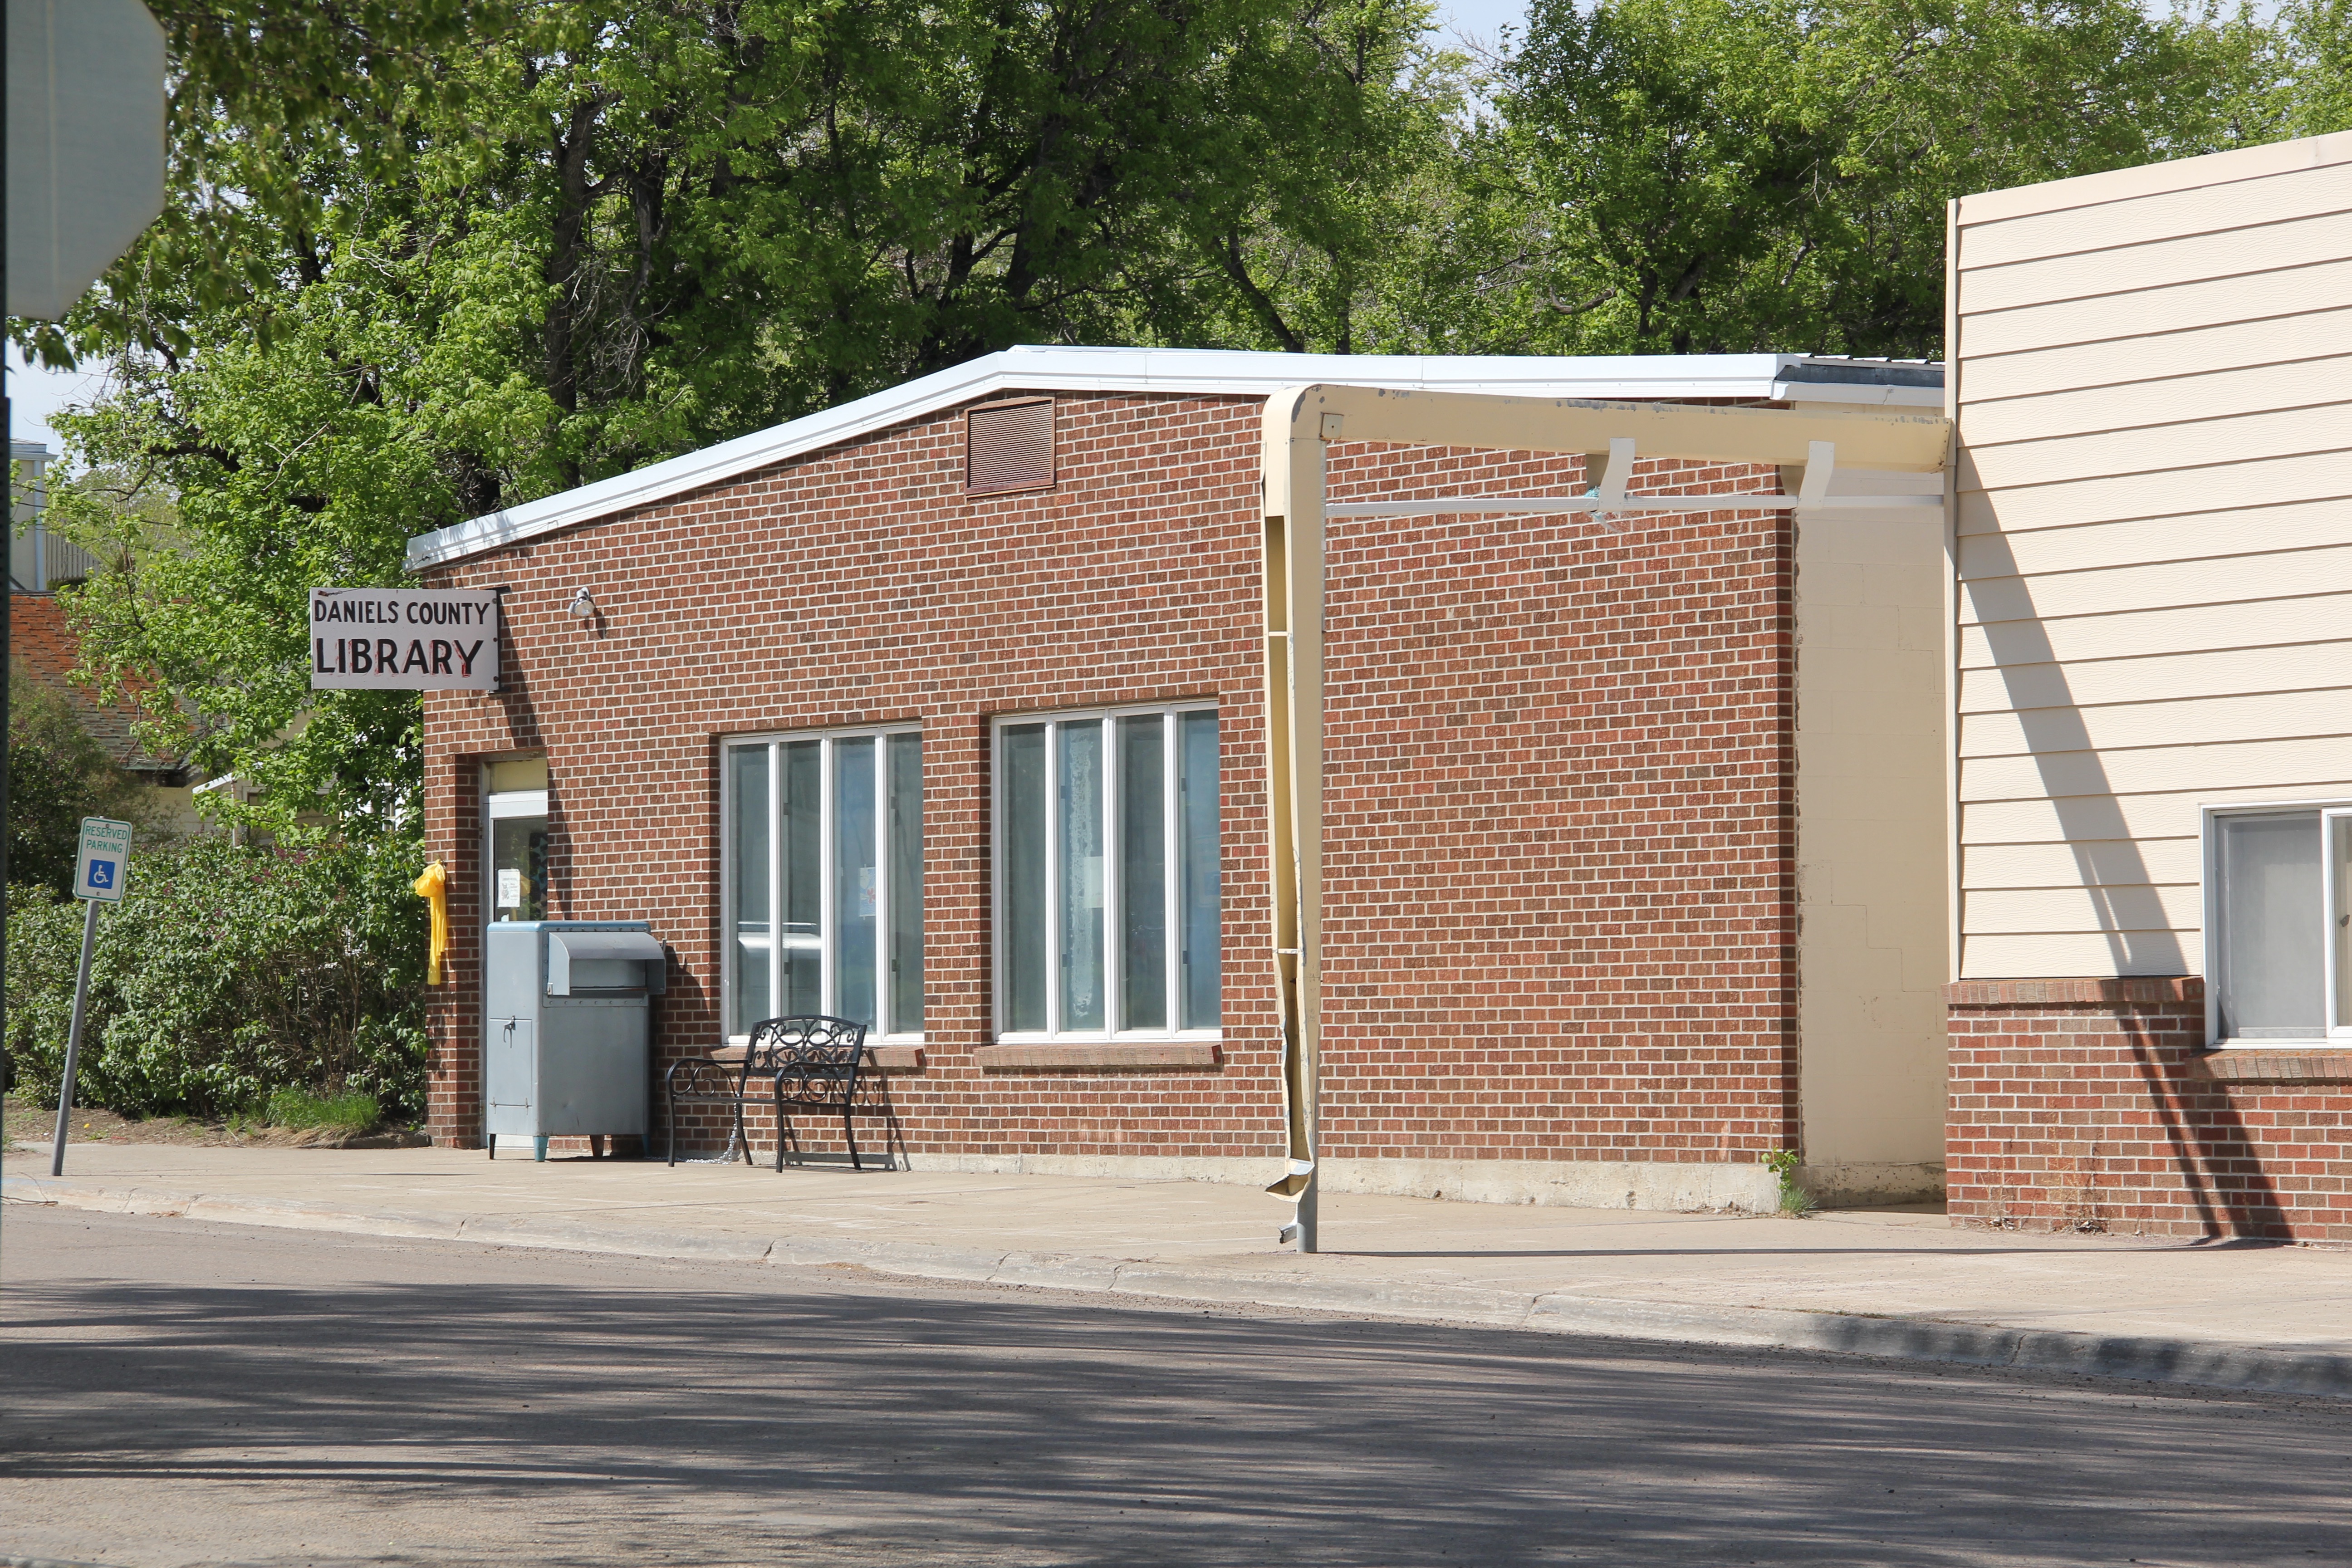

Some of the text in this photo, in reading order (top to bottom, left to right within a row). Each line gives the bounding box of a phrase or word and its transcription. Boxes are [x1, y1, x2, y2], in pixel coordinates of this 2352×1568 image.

[314, 599, 490, 625] DANIELS COUNTY
[316, 638, 484, 675] LIBRARY
[85, 826, 127, 839] RESERVED
[87, 840, 122, 853] PARKING
